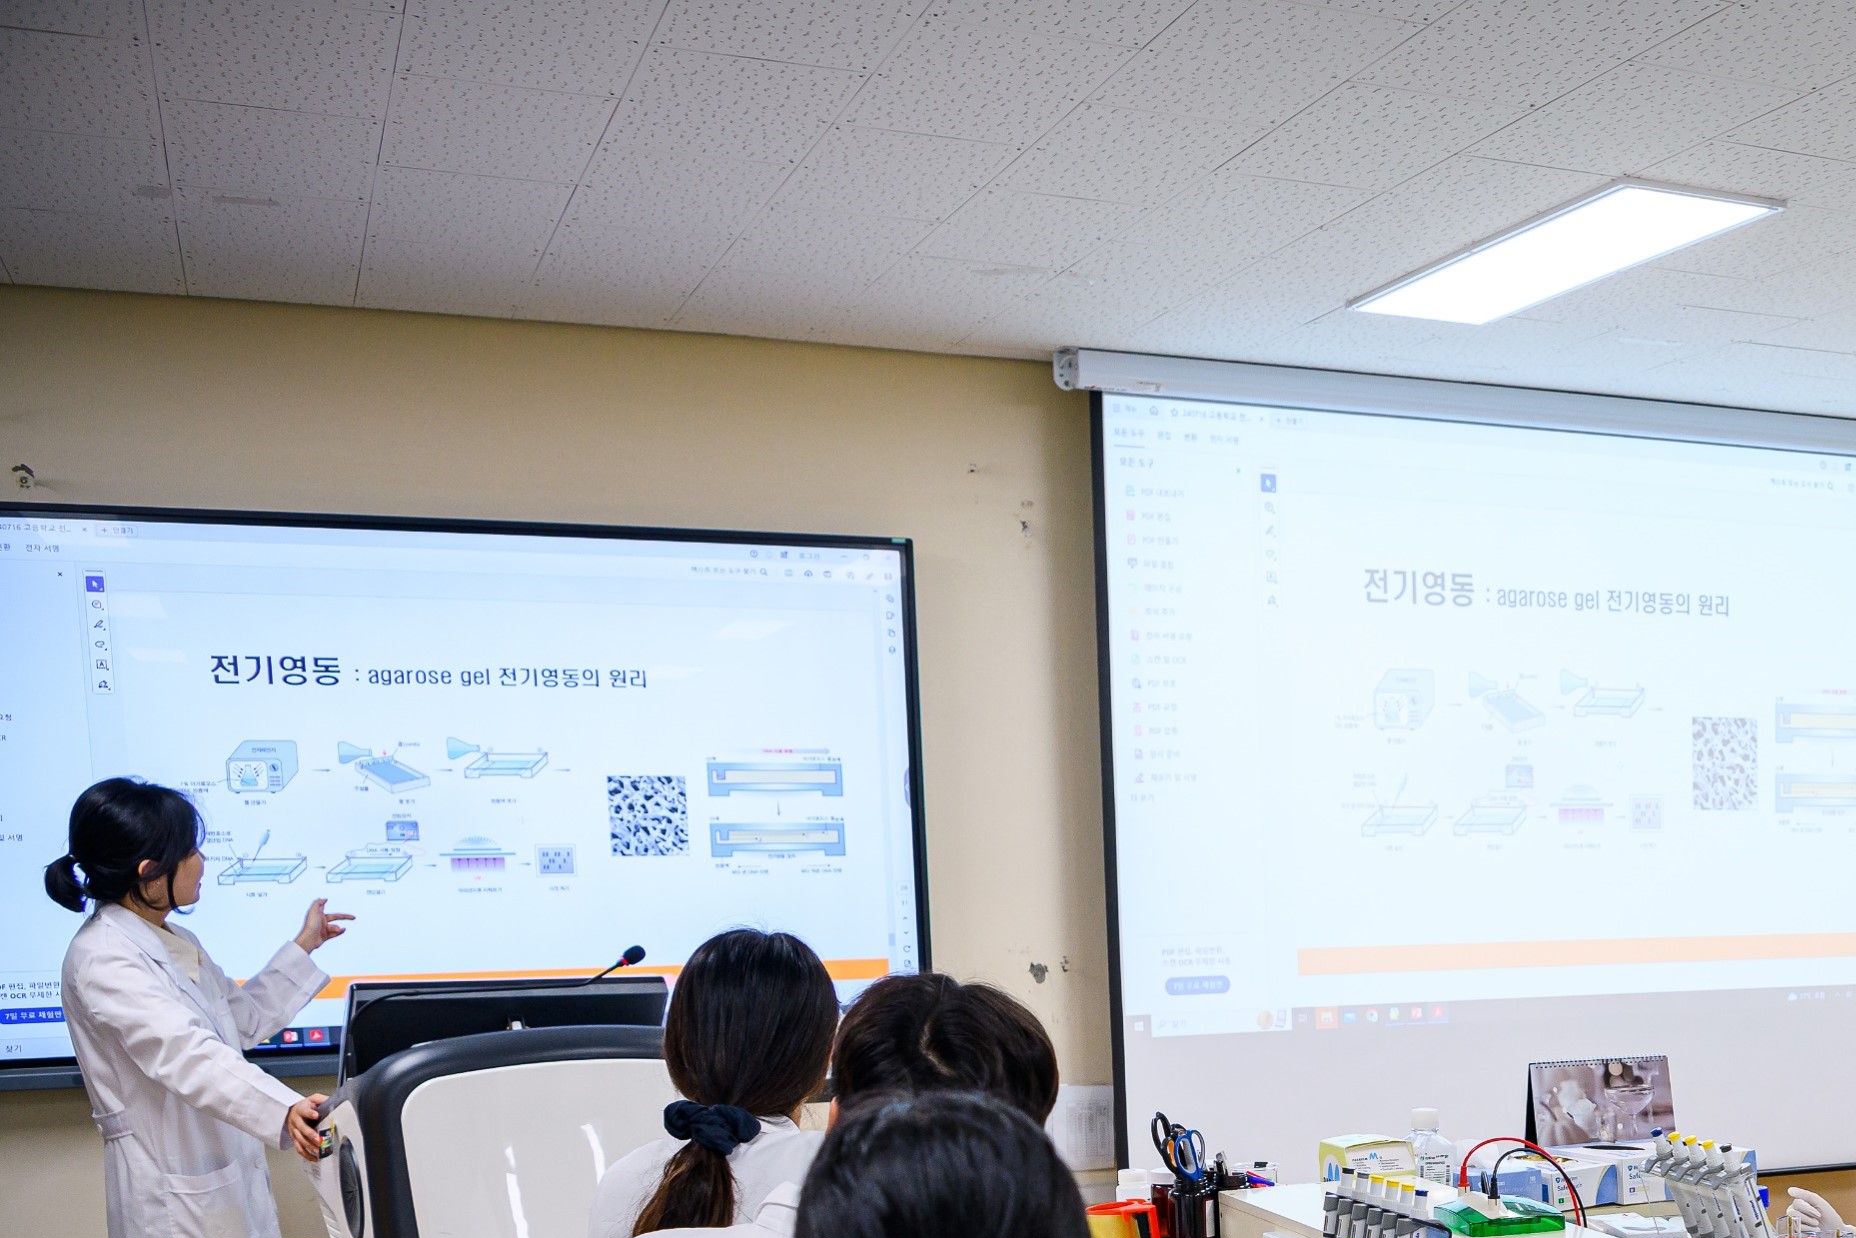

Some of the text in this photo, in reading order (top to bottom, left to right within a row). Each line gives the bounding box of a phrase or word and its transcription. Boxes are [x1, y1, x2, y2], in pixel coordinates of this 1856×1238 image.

[1364, 568, 1475, 607] 전기영동
[1497, 586, 1567, 609] agarose
[1575, 590, 1600, 611] gel
[1607, 589, 1690, 616] 전기영동의
[1698, 594, 1730, 617] 원리
[210, 654, 342, 687] 전기영동
[368, 667, 452, 686] agarose
[461, 668, 491, 687] gel
[498, 667, 600, 688] 전기영동의
[608, 668, 648, 689] 원리
